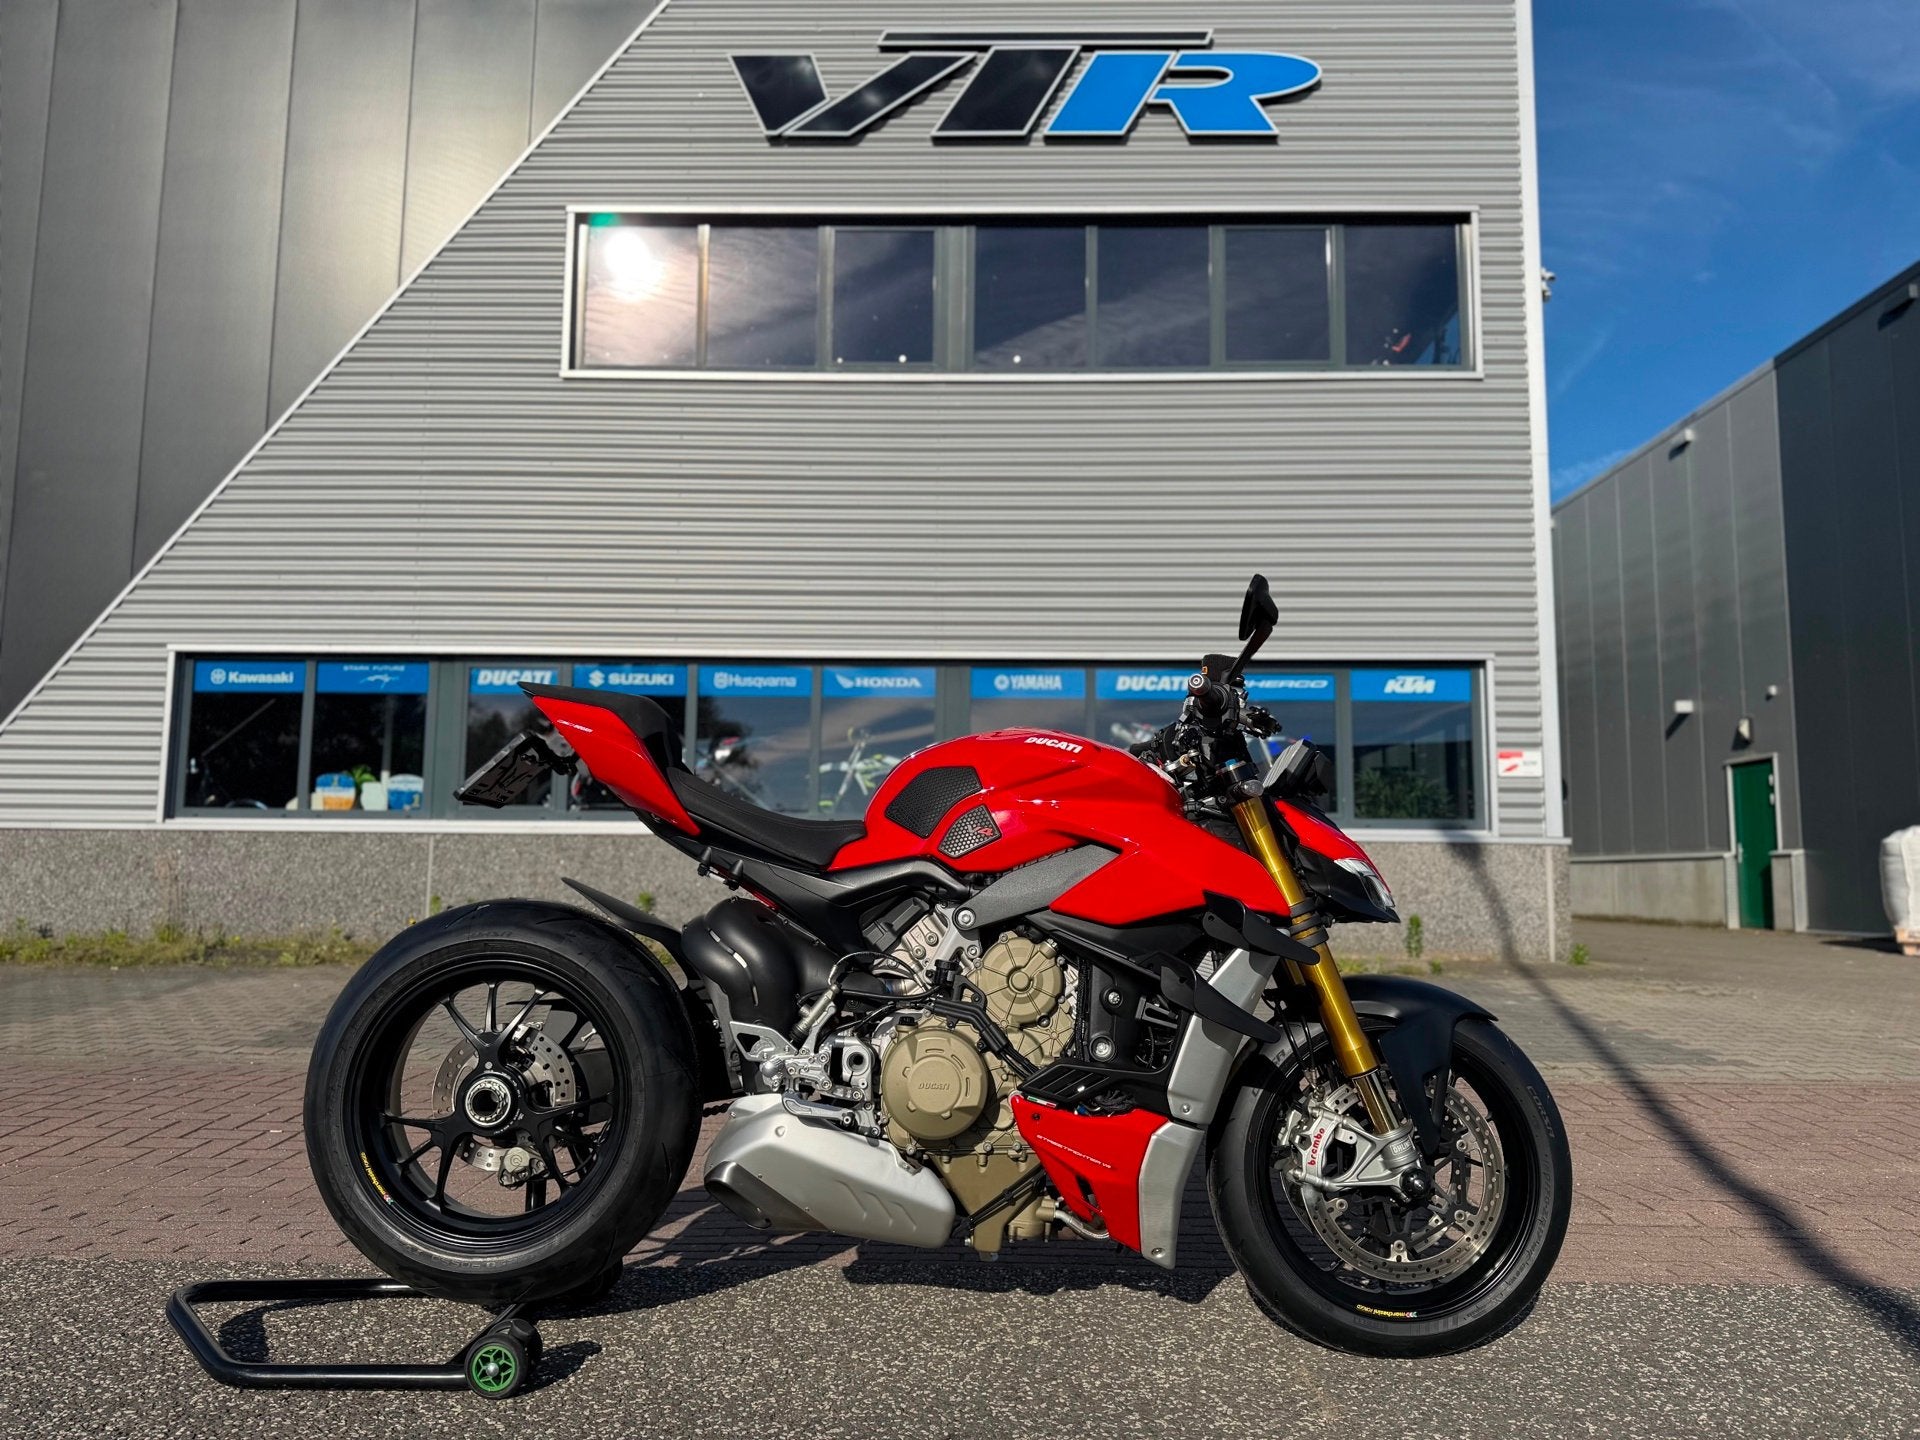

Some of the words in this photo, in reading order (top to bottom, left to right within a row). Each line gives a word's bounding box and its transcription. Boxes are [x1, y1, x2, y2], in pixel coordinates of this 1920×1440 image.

[727, 29, 1321, 135] VTR
[228, 671, 294, 684] Kawasaki
[477, 669, 551, 686] DUCATI
[608, 673, 674, 686] SUZUKI
[729, 674, 797, 688] Husqvarna
[855, 676, 922, 688] HONDA
[1011, 675, 1063, 690] YAMAHA
[1116, 675, 1189, 691] DUCATI
[1244, 680, 1328, 688] HERCO
[1384, 675, 1436, 693] KTM
[1024, 736, 1083, 754] DUCATI
[918, 1082, 950, 1090] DUCATI
[1307, 1127, 1325, 1166] brembo
